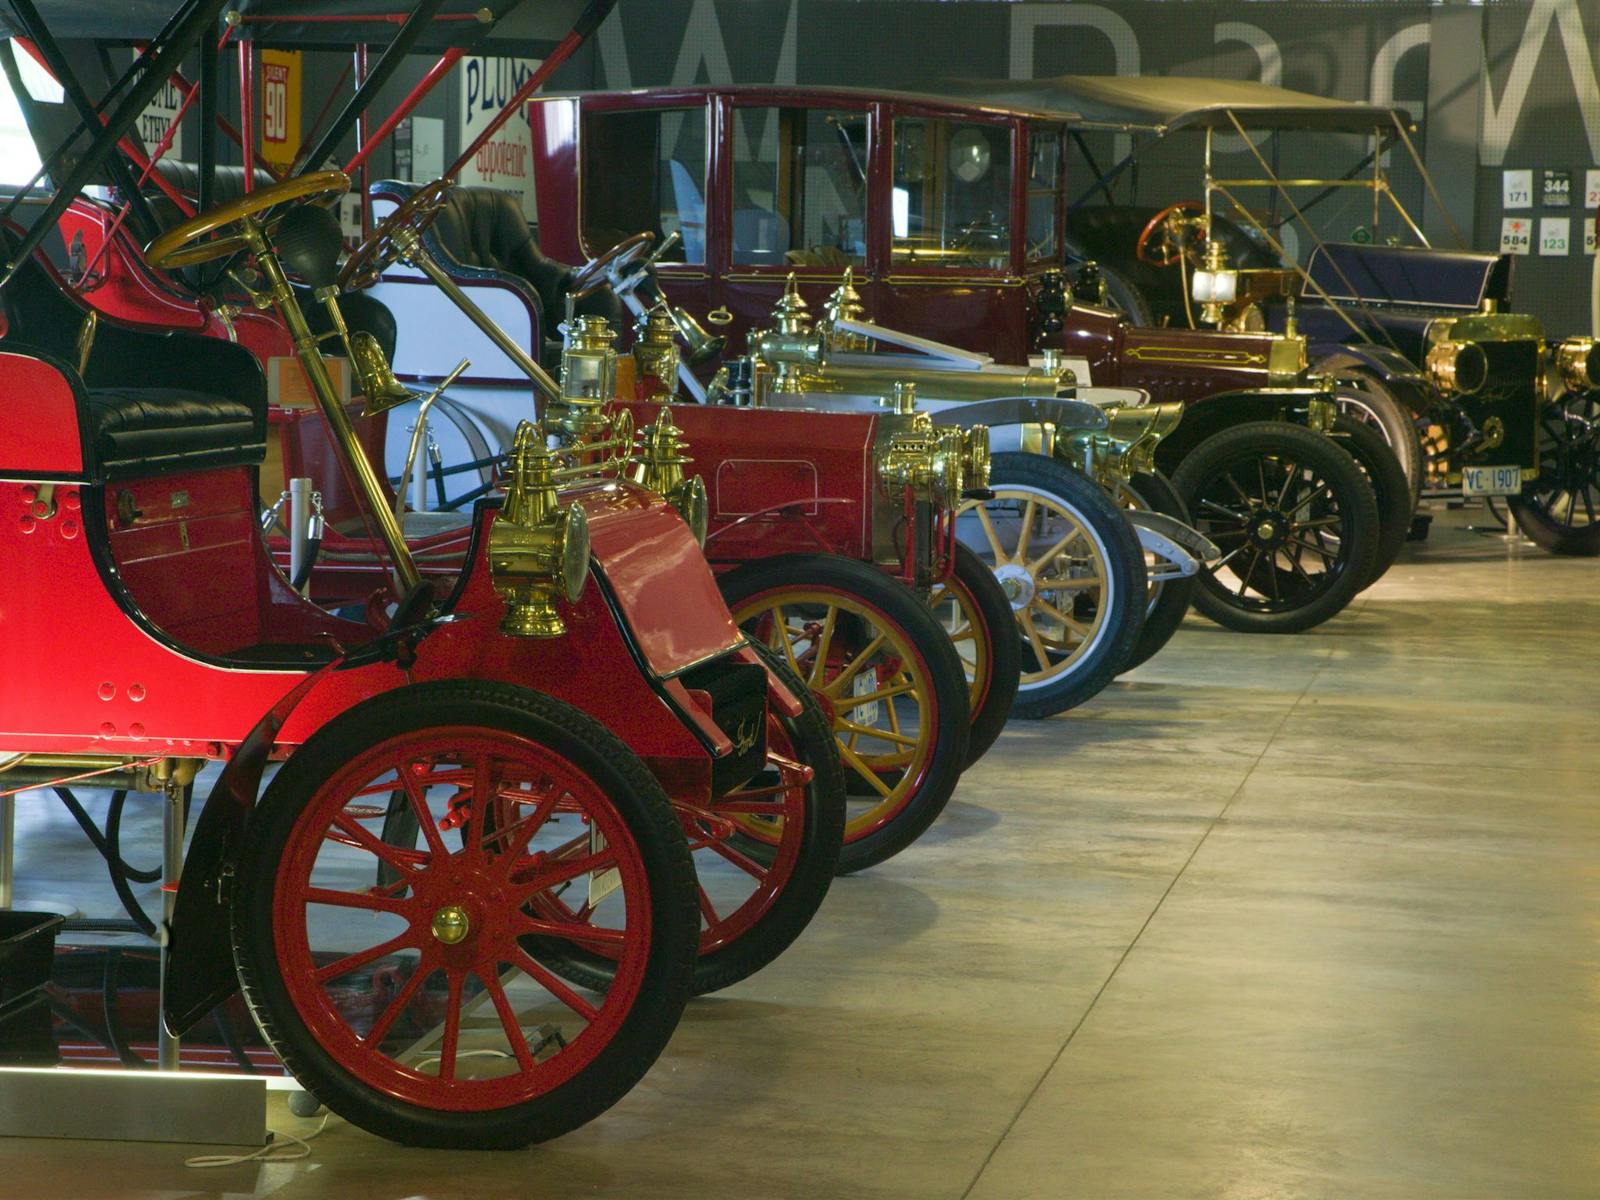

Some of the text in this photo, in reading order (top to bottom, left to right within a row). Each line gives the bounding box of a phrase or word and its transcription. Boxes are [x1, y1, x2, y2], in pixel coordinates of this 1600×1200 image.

[466, 56, 534, 126] PLUM
[265, 81, 286, 139] 90
[1544, 180, 1570, 193] 344
[1509, 192, 1528, 202] 171
[1502, 235, 1528, 245] 584
[1543, 239, 1566, 249] 123
